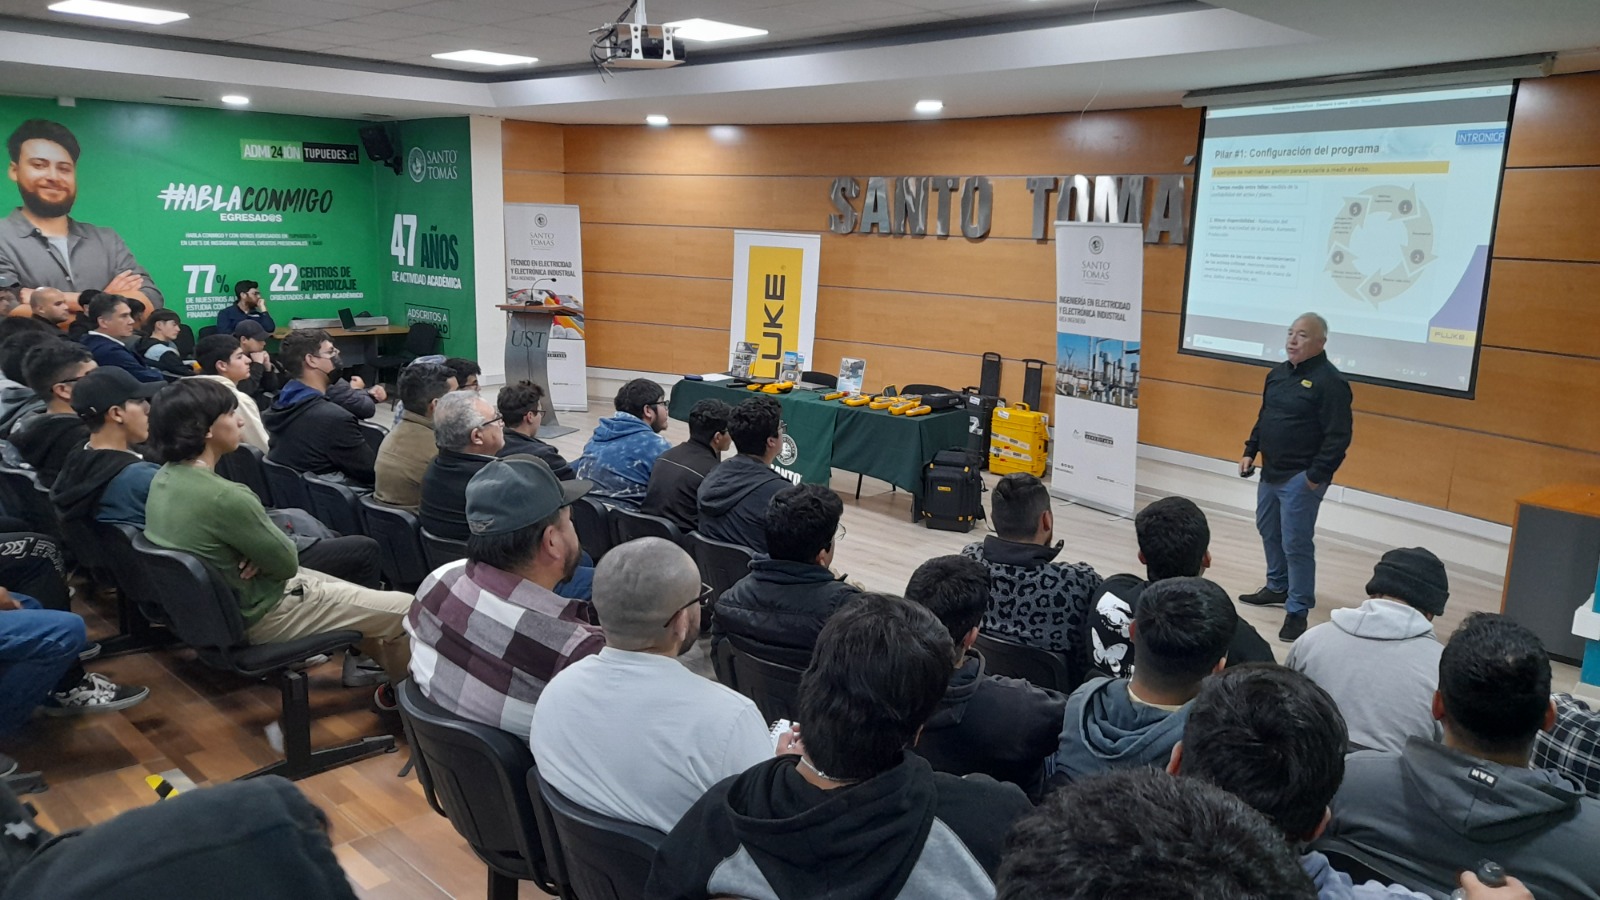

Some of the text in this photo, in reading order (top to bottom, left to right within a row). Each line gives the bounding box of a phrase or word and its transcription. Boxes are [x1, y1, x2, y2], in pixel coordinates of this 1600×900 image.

[427, 150, 457, 164] SANTO
[1215, 144, 1380, 159] Pilar #1: Configuración del programa
[427, 164, 458, 180] TOMÁS
[829, 155, 1196, 244] SANTO TOMÁ
[390, 214, 418, 266] 47
[420, 224, 459, 271] AÑOS
[300, 266, 351, 278] CENTROS DE
[1081, 260, 1110, 270] SANTO
[268, 264, 298, 292] 22
[300, 280, 356, 291] APRENDIZAJE
[408, 308, 448, 322] ADSCRITOS A
[511, 330, 546, 348] UST
